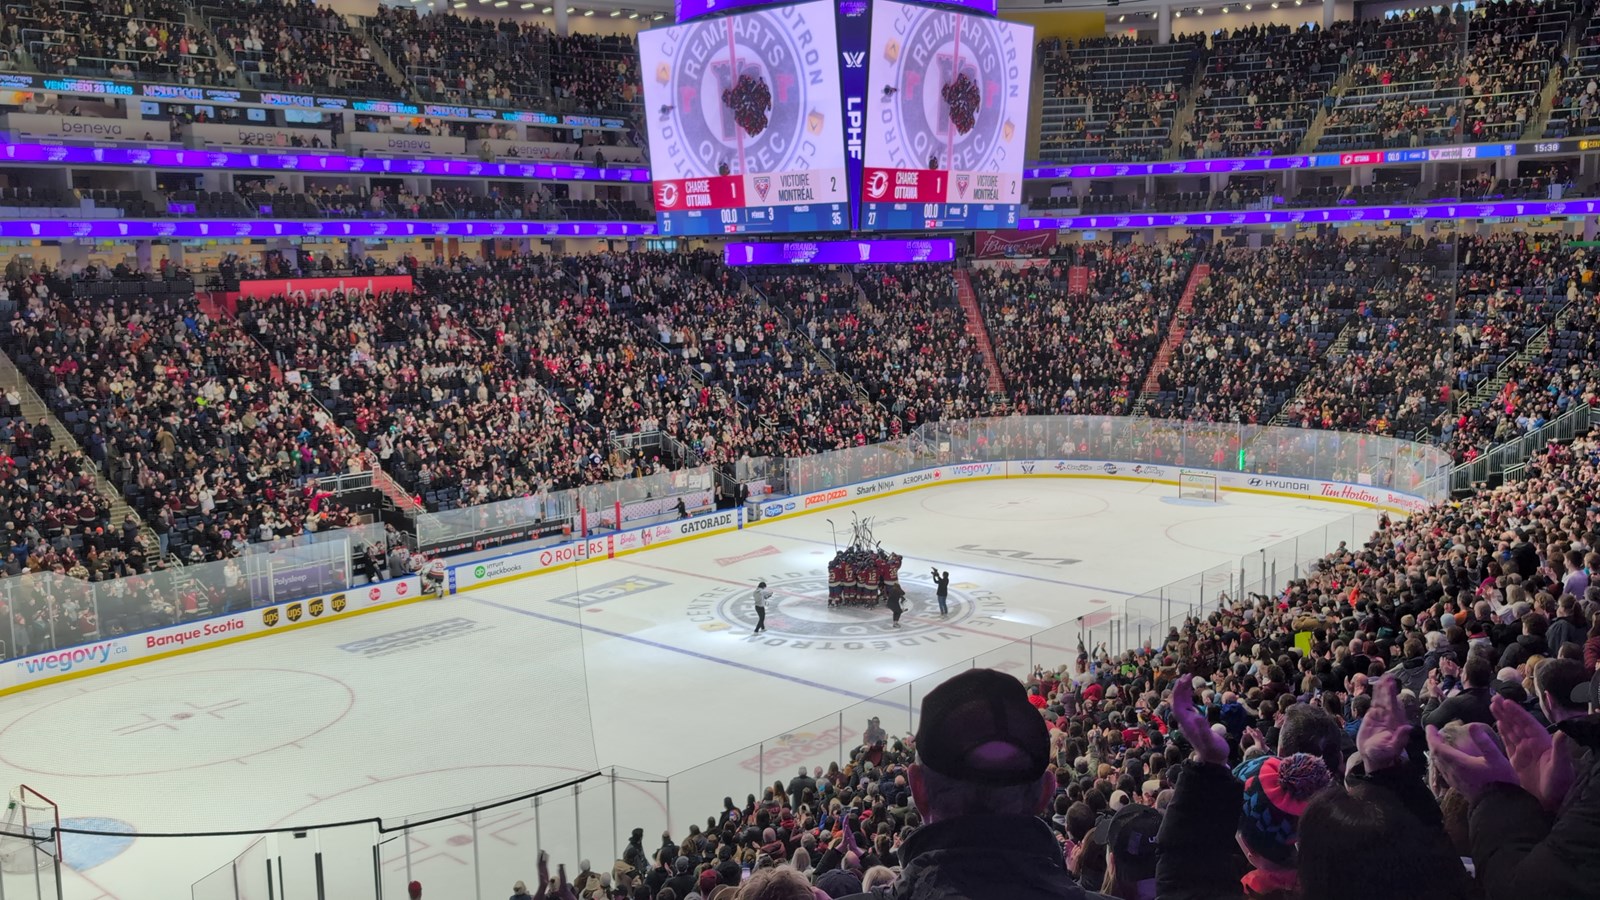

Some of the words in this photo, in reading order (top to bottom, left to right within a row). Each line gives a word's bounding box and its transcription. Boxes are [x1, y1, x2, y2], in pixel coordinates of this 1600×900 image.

[685, 17, 785, 79] REMPARTS
[913, 14, 996, 73] REMPARTS
[44, 79, 92, 93] VENDREDI
[106, 83, 133, 95] MARS
[62, 117, 122, 135] beneva
[847, 97, 862, 160] LPHF
[238, 128, 289, 143] bene
[388, 136, 431, 150] beneva
[1534, 143, 1560, 152] 15:38
[1466, 148, 1472, 157] 2
[780, 173, 810, 187] VICTOIRE
[830, 176, 837, 192] 2
[895, 171, 919, 185] CHARGE
[977, 175, 998, 187] VICTOIRE
[685, 180, 710, 193] CHARGE
[731, 182, 736, 199] 1
[894, 186, 918, 199] OTTAWA
[936, 177, 941, 194] 1
[1010, 180, 1016, 195] 2
[686, 194, 712, 207] OTTAWA
[778, 186, 814, 201] MONTRÉAL
[973, 186, 999, 201] MONTRÉAL
[720, 208, 738, 223] 00.0
[768, 207, 774, 221] 3
[923, 203, 939, 218] 00.0
[963, 204, 968, 217] 3
[831, 212, 842, 225] 35
[867, 212, 877, 225] 27
[663, 220, 671, 232] 27
[952, 463, 993, 476] wegovy
[903, 473, 932, 485] AEROPLAN
[1265, 479, 1310, 491] HYUNDAI
[856, 484, 876, 496] Shark
[878, 481, 894, 492] NINJA
[1320, 483, 1340, 497] Tim
[1341, 485, 1379, 503] Hortons
[805, 494, 825, 508] pizza
[826, 489, 848, 503] pizza
[681, 514, 732, 534] GATORADE
[556, 542, 603, 562] ROERS
[487, 564, 522, 578] quickbooks
[868, 572, 877, 580] 12
[274, 574, 307, 586] Polysleep
[308, 602, 324, 615] ups
[331, 597, 346, 610] ups
[686, 586, 735, 622] CENTRE
[263, 612, 278, 624] ups
[286, 607, 302, 620] ups
[146, 629, 201, 649] Banque
[203, 618, 244, 636] Scotia
[25, 643, 112, 674] wegovy
